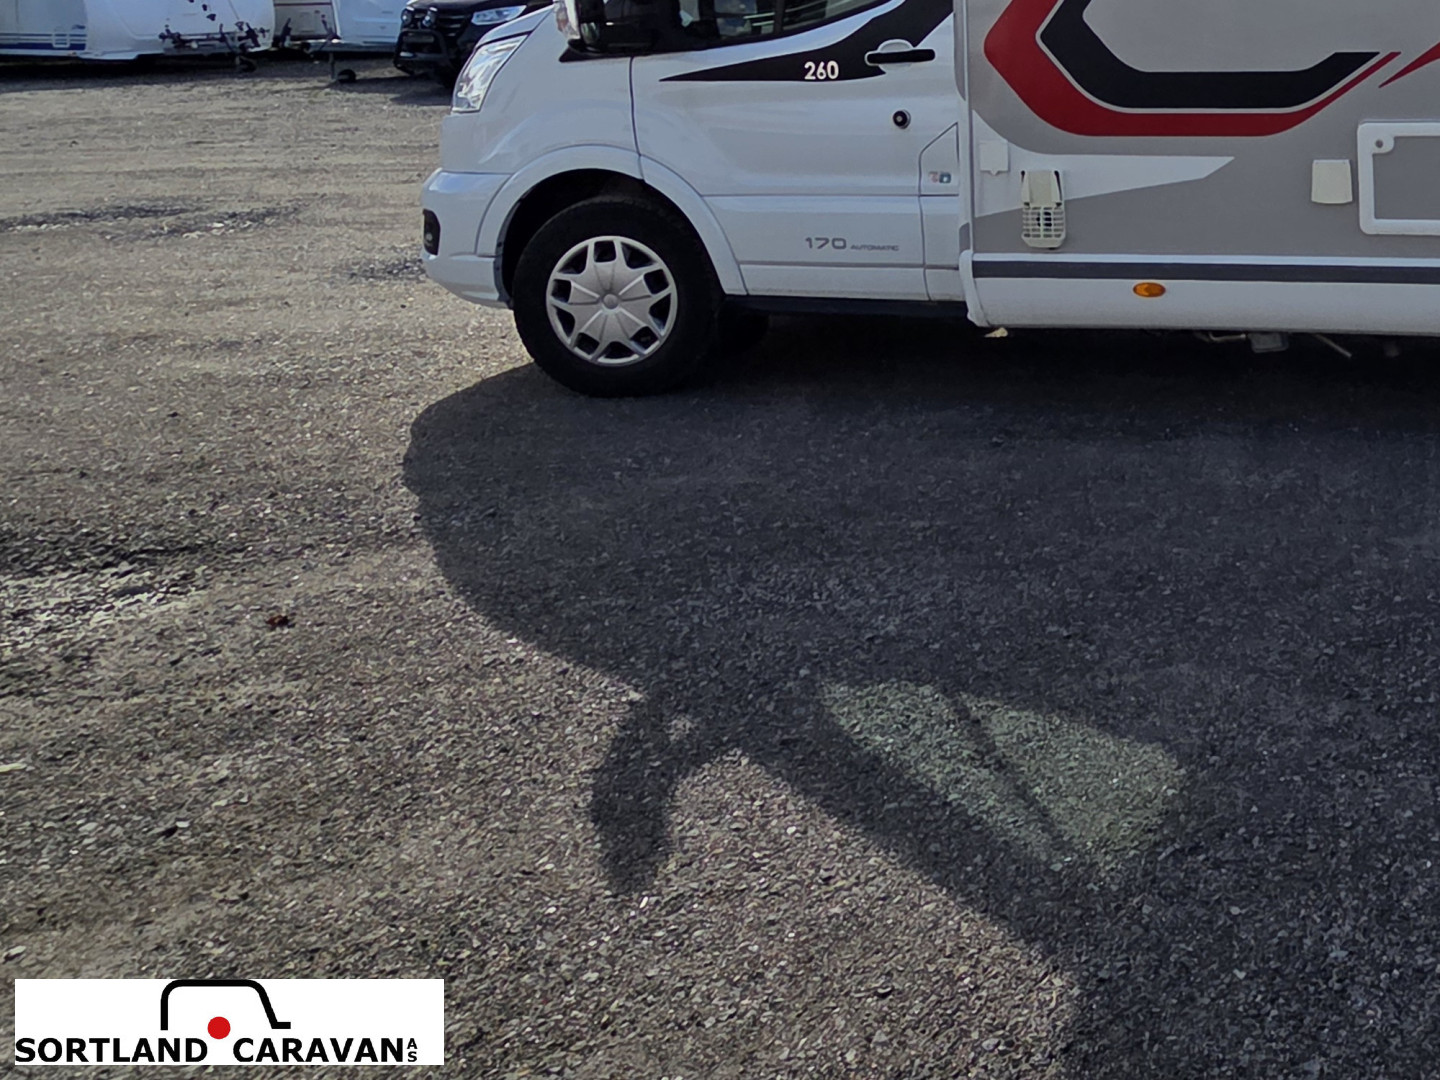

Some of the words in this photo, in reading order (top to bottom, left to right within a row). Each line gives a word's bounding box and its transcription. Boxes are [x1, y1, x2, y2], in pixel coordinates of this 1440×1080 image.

[804, 60, 840, 80] 260
[805, 237, 847, 250] 170
[850, 244, 900, 252] AUTOMATIC
